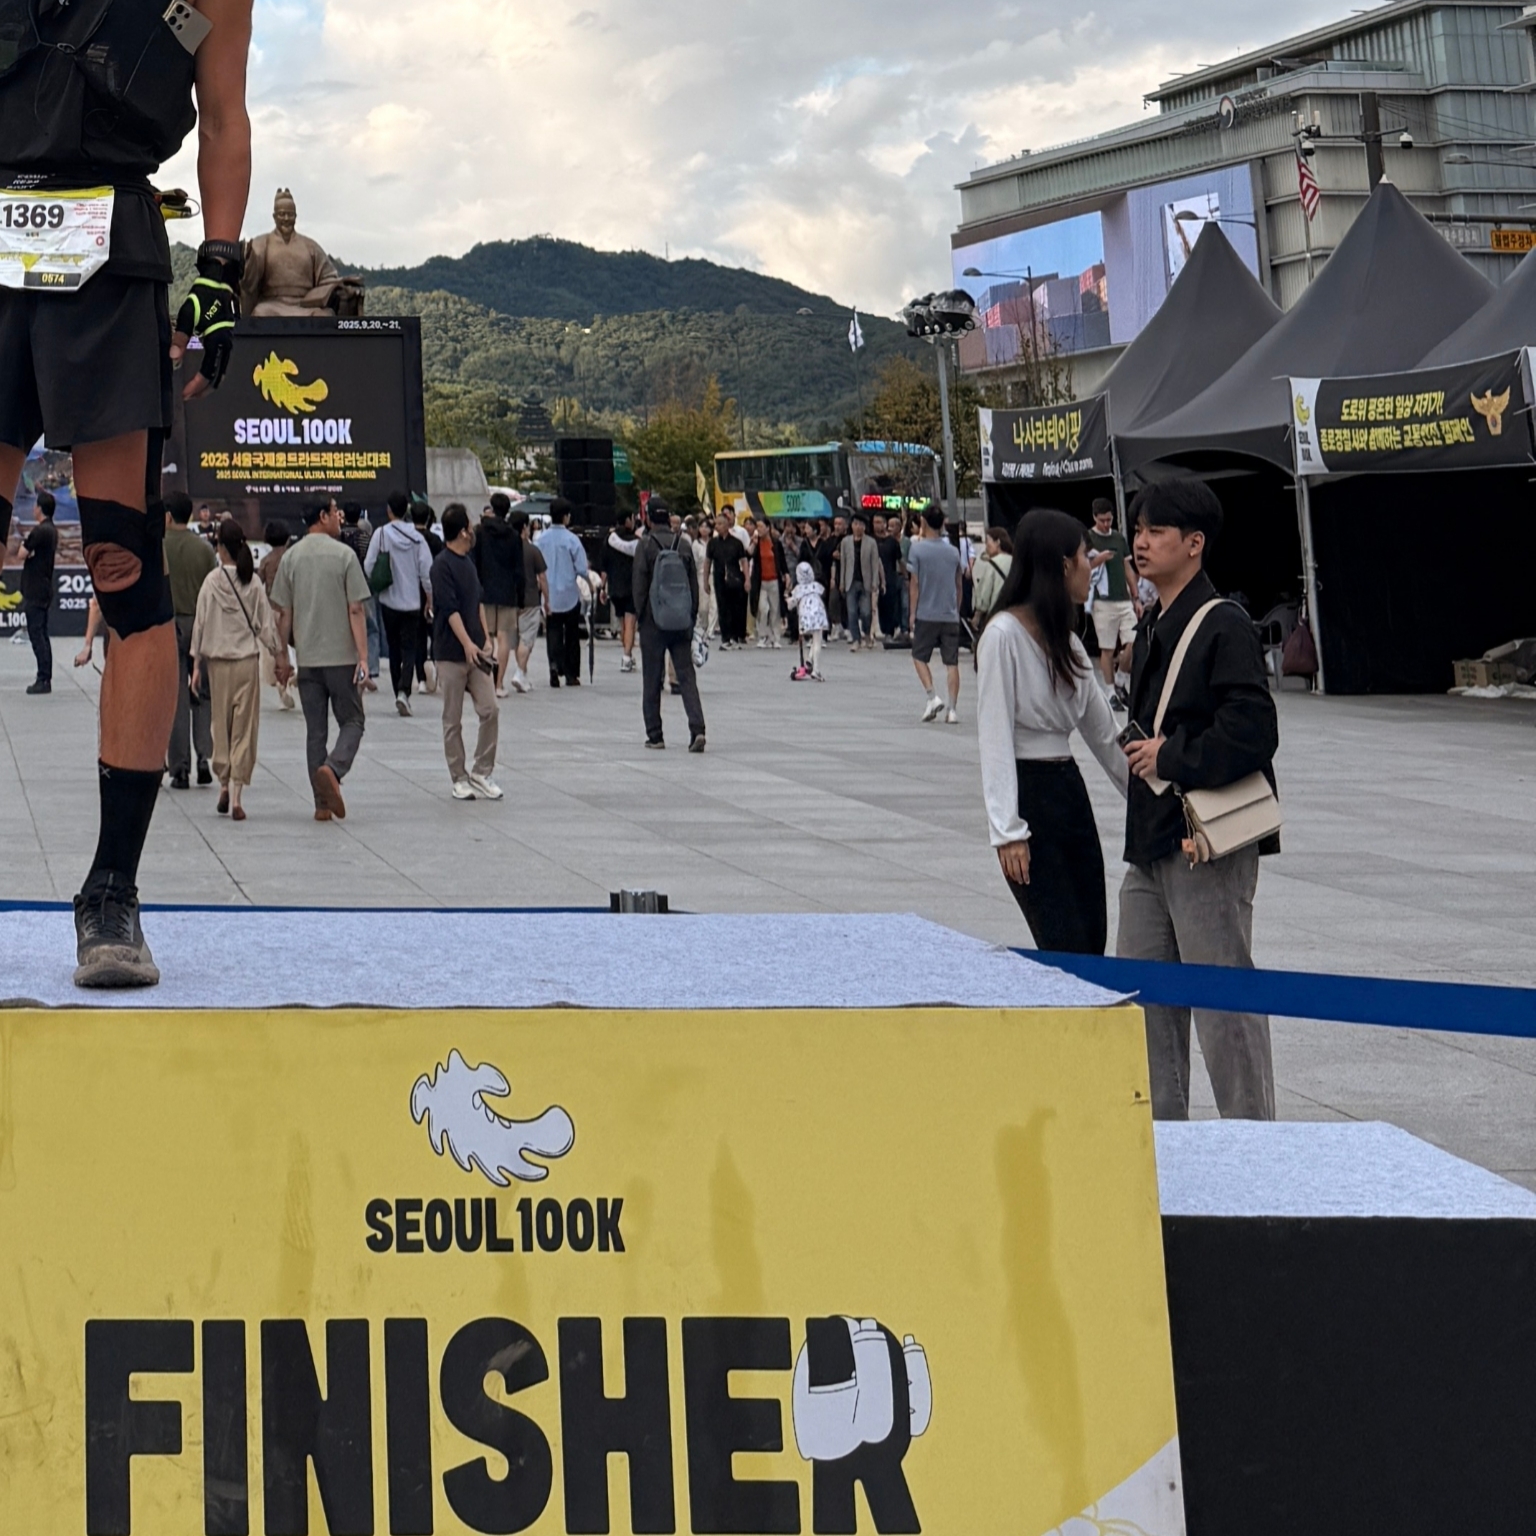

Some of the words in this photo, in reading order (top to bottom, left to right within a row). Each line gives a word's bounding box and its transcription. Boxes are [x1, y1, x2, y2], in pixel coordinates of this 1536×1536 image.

[3, 204, 64, 228] 1369
[41, 273, 65, 284] 0574
[1340, 397, 1367, 422] 도로위
[1368, 395, 1394, 421] 평온한
[1395, 393, 1413, 420] 일상
[1013, 408, 1082, 455] 나사라테이핑
[200, 452, 230, 469] 2025
[58, 575, 94, 593] 202
[59, 598, 87, 610] 2025
[84, 1315, 920, 1536] FINISHER
